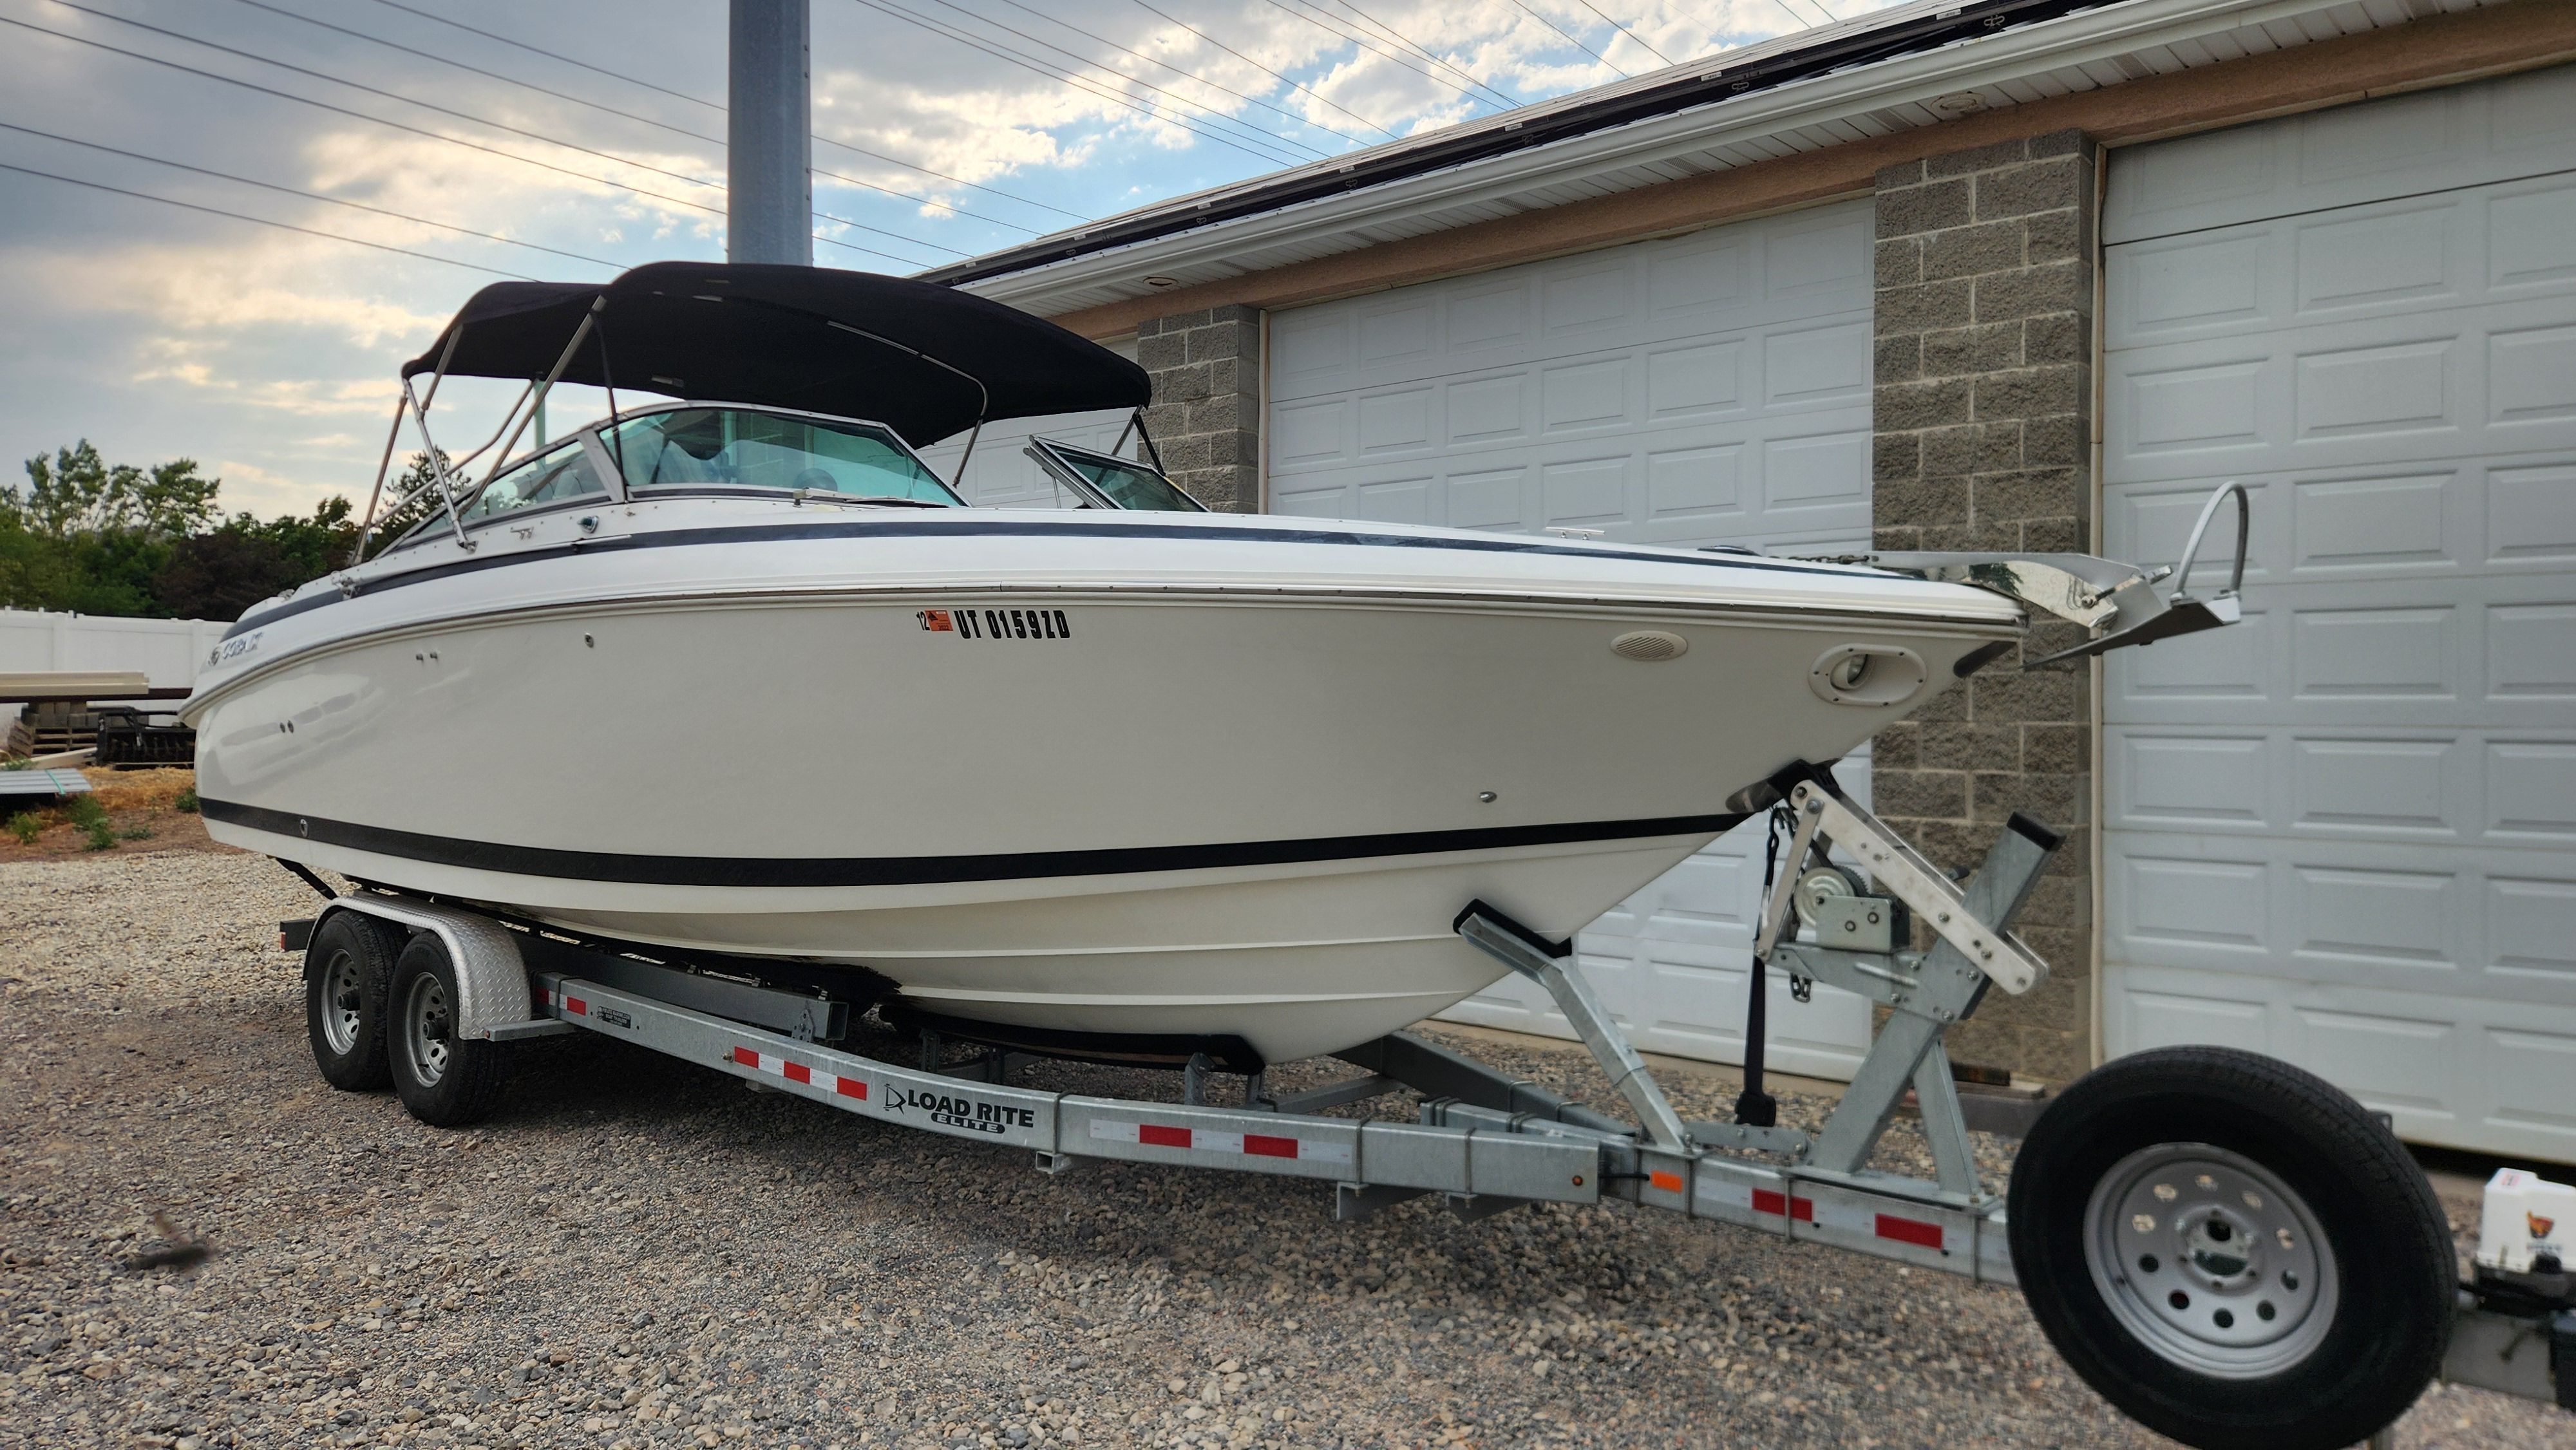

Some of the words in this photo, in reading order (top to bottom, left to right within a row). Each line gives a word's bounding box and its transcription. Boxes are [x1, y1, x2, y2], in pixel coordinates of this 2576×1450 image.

[916, 611, 931, 631] 12
[953, 610, 982, 639] UT
[907, 1089, 971, 1117] LOAD
[977, 1102, 1034, 1128] RITE
[936, 1113, 999, 1133] ELITE
